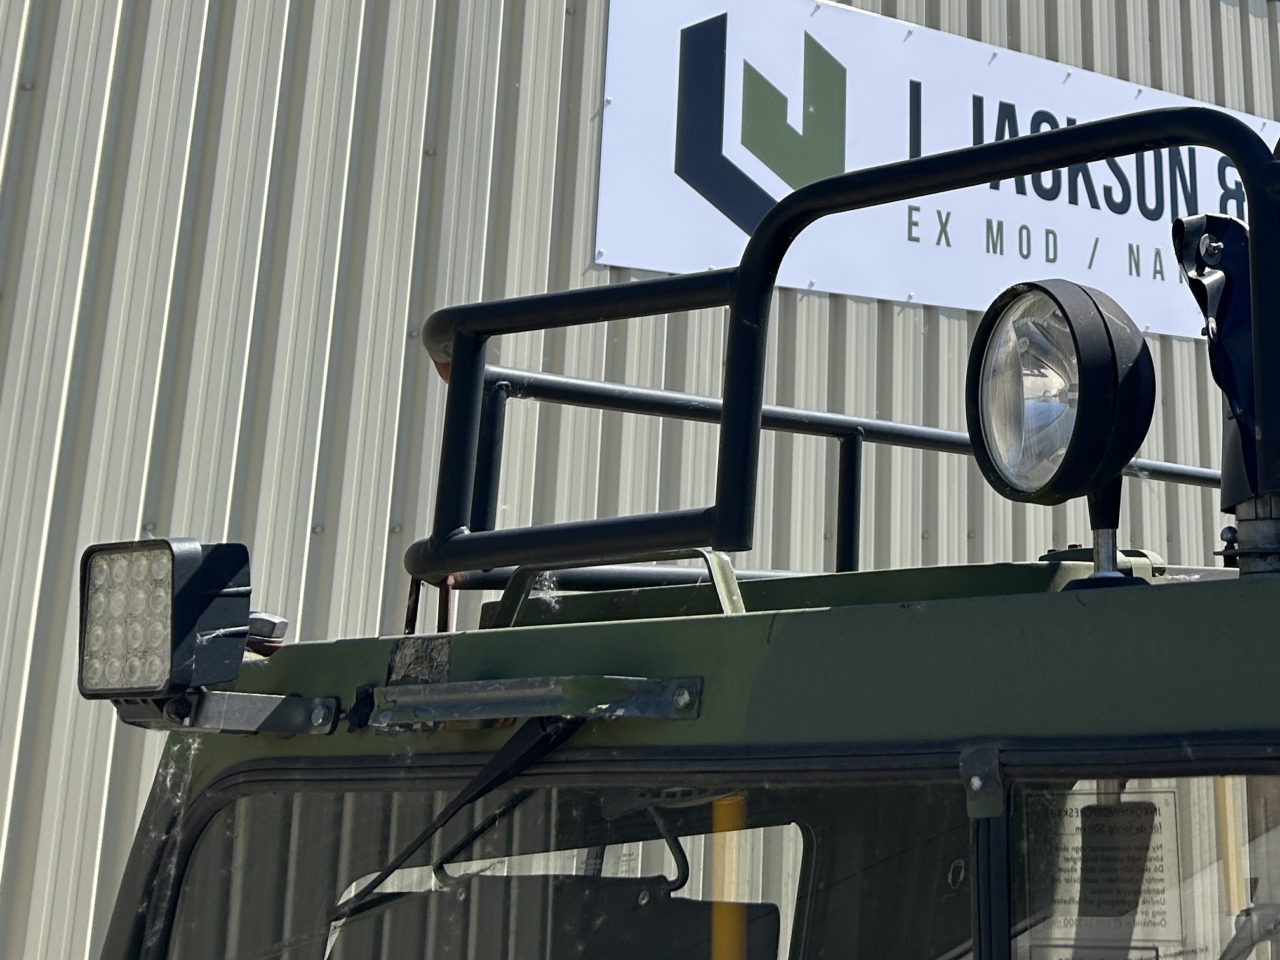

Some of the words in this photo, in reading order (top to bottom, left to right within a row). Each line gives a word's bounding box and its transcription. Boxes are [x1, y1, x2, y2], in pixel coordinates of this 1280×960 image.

[907, 205, 951, 247] EX
[986, 218, 1058, 263] MOD
[1088, 238, 1099, 269] /
